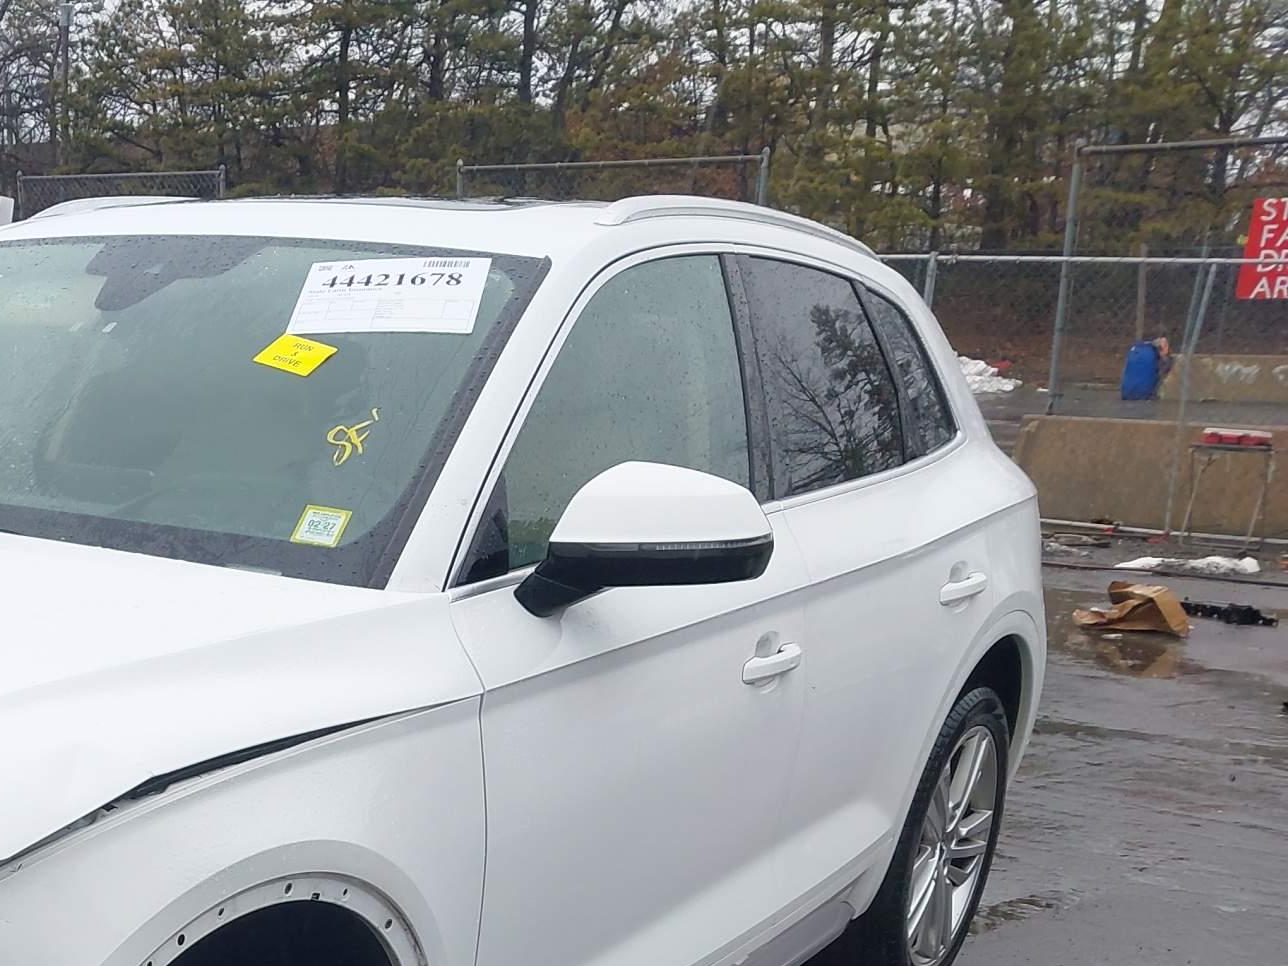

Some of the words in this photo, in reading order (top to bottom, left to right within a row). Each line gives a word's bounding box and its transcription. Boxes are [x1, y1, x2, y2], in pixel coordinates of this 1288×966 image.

[322, 271, 464, 289] 44421678
[293, 342, 314, 352] RUN
[272, 354, 302, 368] DRIVE
